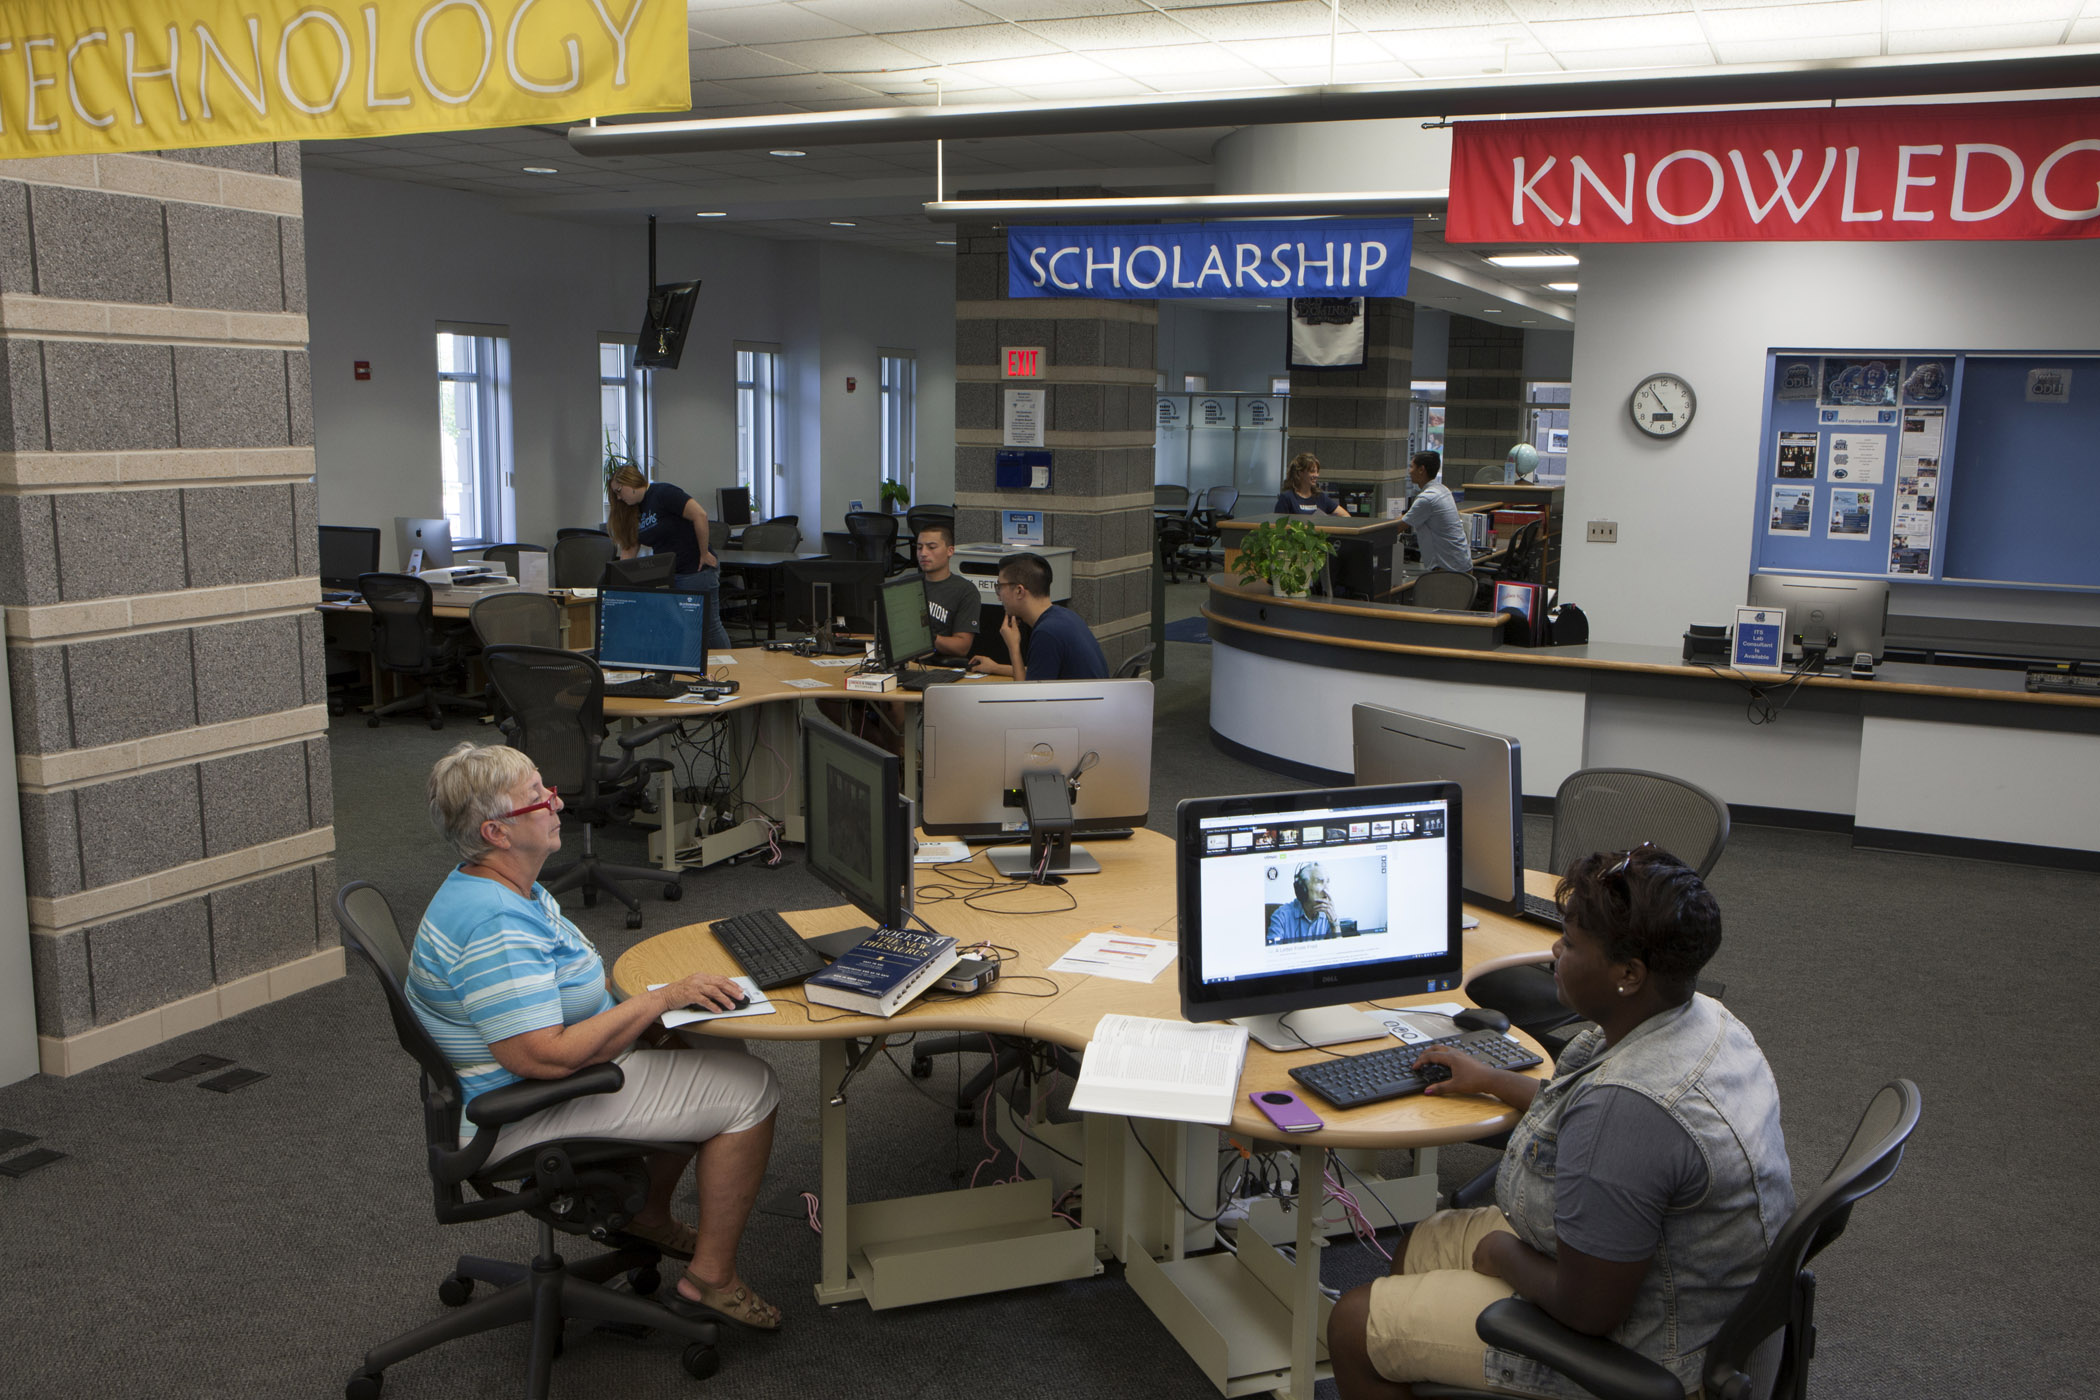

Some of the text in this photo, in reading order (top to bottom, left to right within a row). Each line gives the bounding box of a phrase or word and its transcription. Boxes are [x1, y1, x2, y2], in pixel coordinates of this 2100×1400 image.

[1029, 241, 1387, 290] SCHOLARSHIP
[1008, 350, 1038, 376] EXIT
[2032, 383, 2063, 395] ODU
[862, 940, 930, 958] THESAURUS
[877, 936, 928, 950] THE NEW
[932, 938, 946, 947] II
[1322, 975, 1339, 983] DELL
